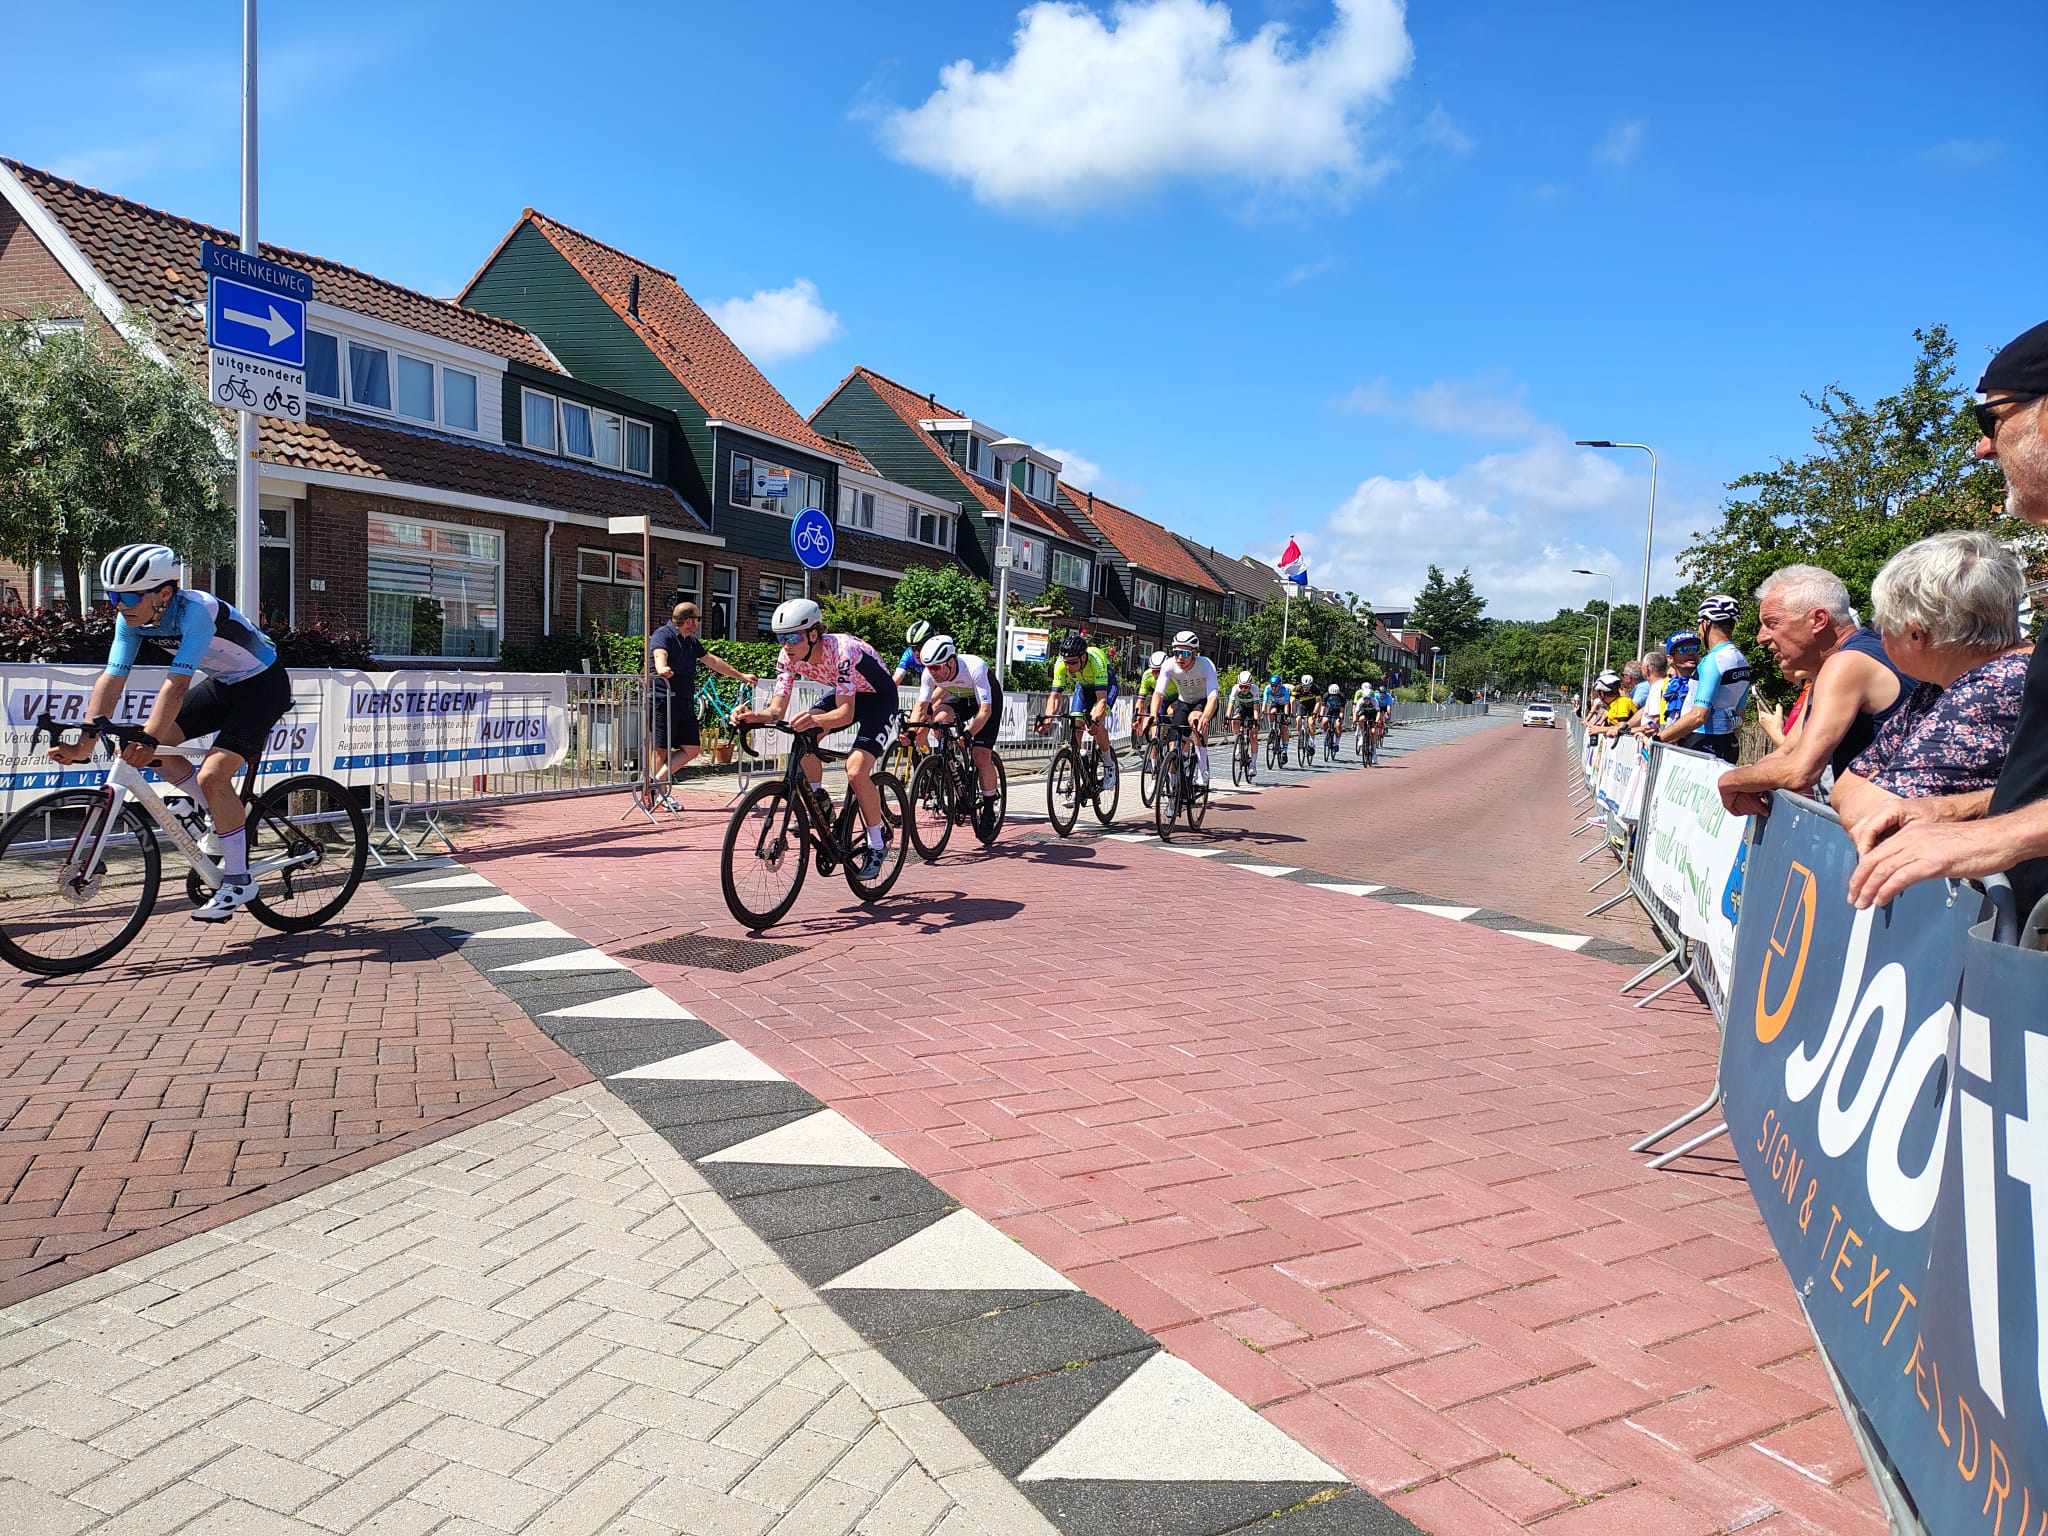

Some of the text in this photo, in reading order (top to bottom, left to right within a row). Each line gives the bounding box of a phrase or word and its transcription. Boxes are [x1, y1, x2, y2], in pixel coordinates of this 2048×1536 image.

[213, 251, 305, 293] SCHENKELWEG
[217, 356, 302, 385] uitgezonderd
[356, 692, 477, 714] VERSTEEGEN
[343, 722, 371, 735] Verkoop
[481, 719, 540, 741] AUTO'S
[338, 740, 373, 751] Reparatie
[1757, 1109, 1804, 1205] SIGN
[1798, 1178, 1818, 1236] &
